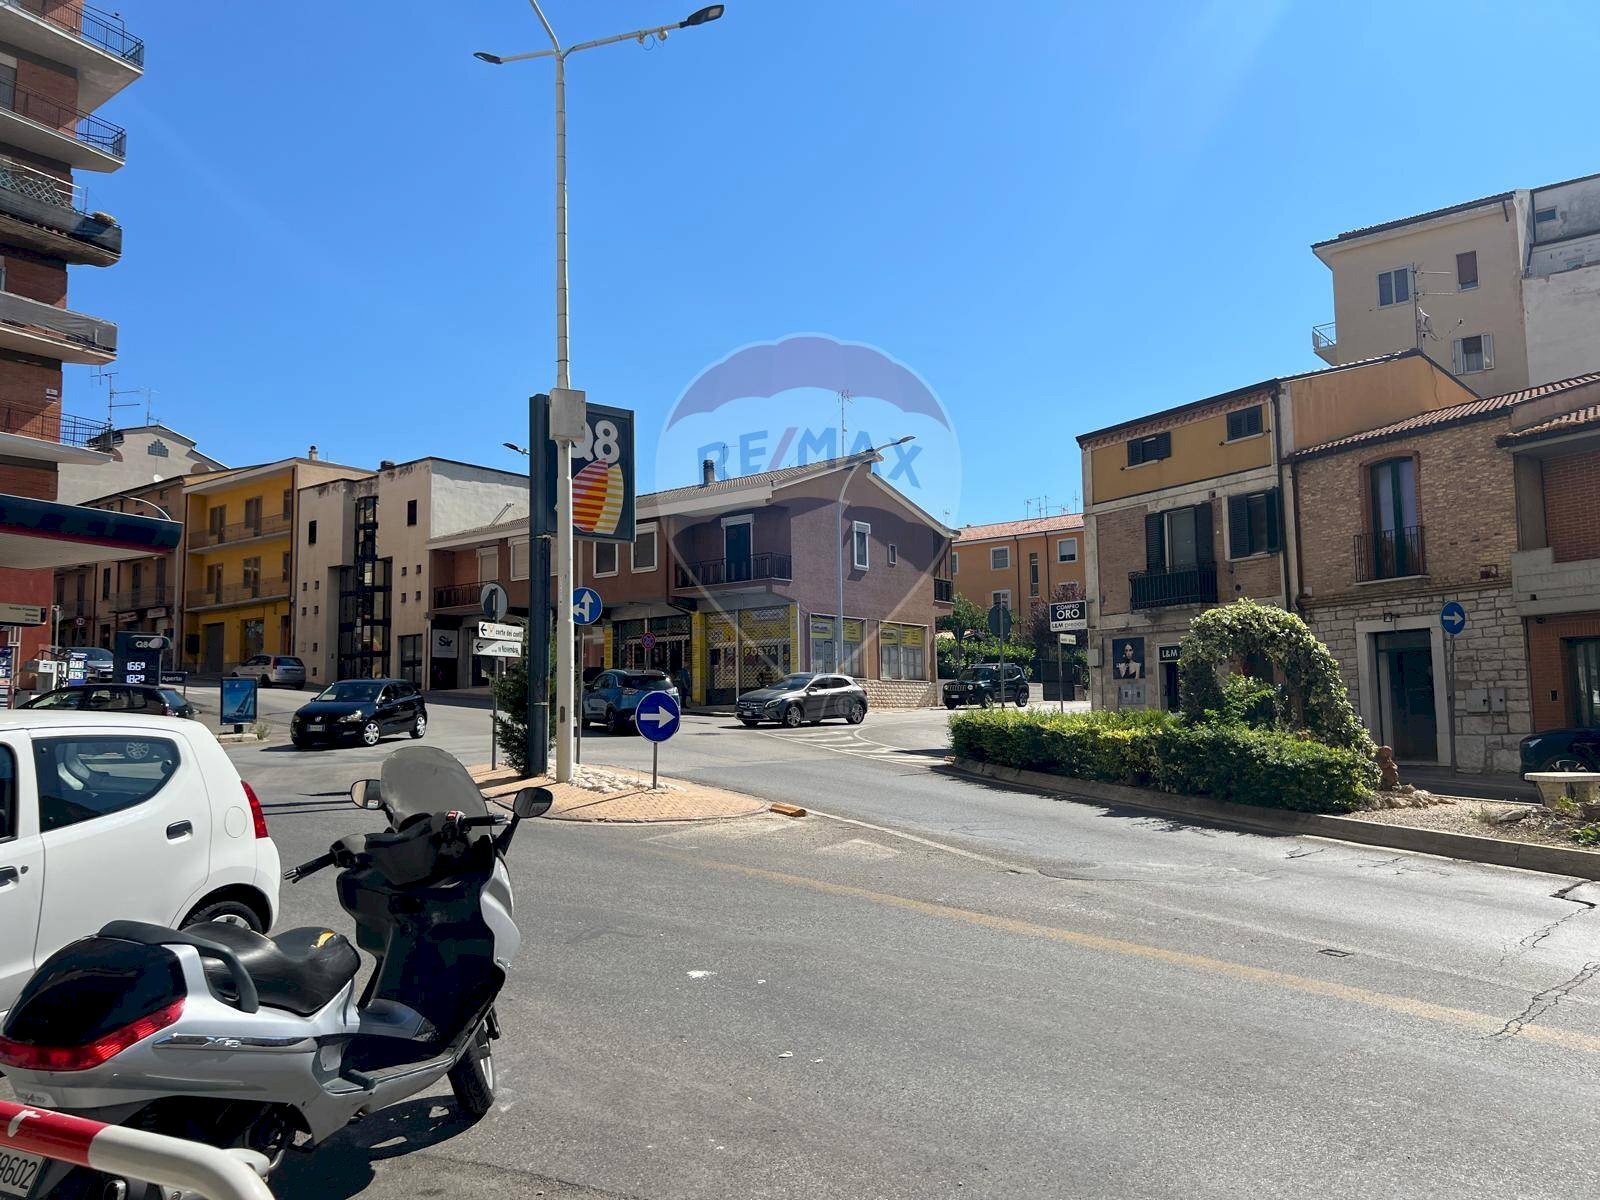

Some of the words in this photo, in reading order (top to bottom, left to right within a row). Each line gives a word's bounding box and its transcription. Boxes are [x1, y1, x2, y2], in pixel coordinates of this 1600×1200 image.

[1056, 609, 1080, 619] ORO
[744, 645, 778, 656] POSTA
[1162, 649, 1178, 658] L&M
[161, 675, 183, 683] Aperto
[0, 1152, 38, 1190] 9602
